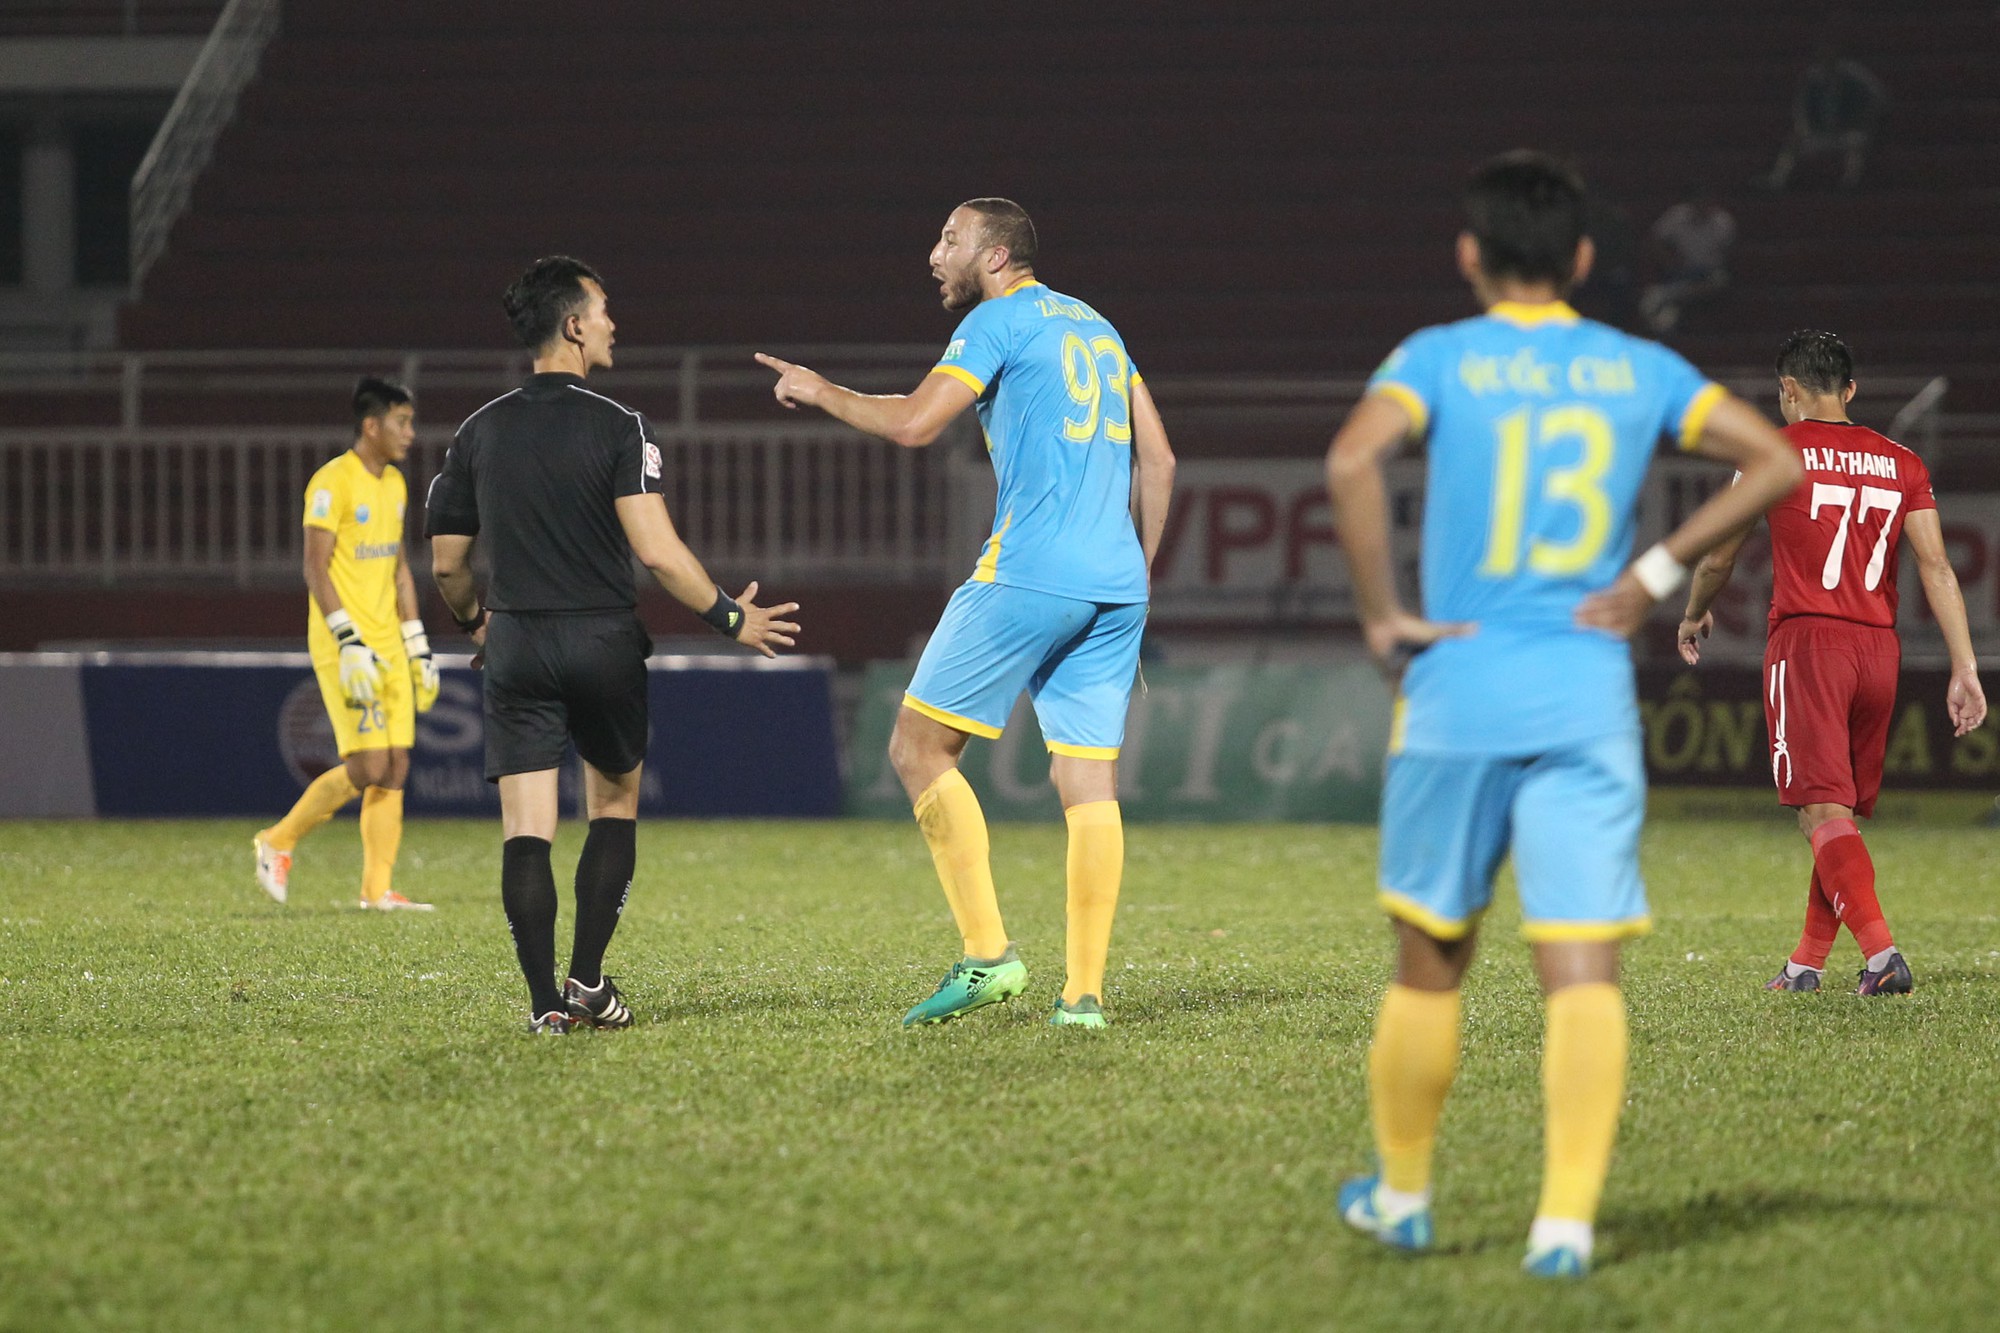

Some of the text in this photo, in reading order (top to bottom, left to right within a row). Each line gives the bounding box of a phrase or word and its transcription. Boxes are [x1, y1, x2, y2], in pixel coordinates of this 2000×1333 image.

[1061, 331, 1131, 443] 93
[1476, 402, 1614, 580] 13
[1802, 447, 1898, 480] H.V.THANH
[1810, 482, 1903, 592] 77
[357, 698, 387, 734] 26
[967, 973, 997, 999] adidas
